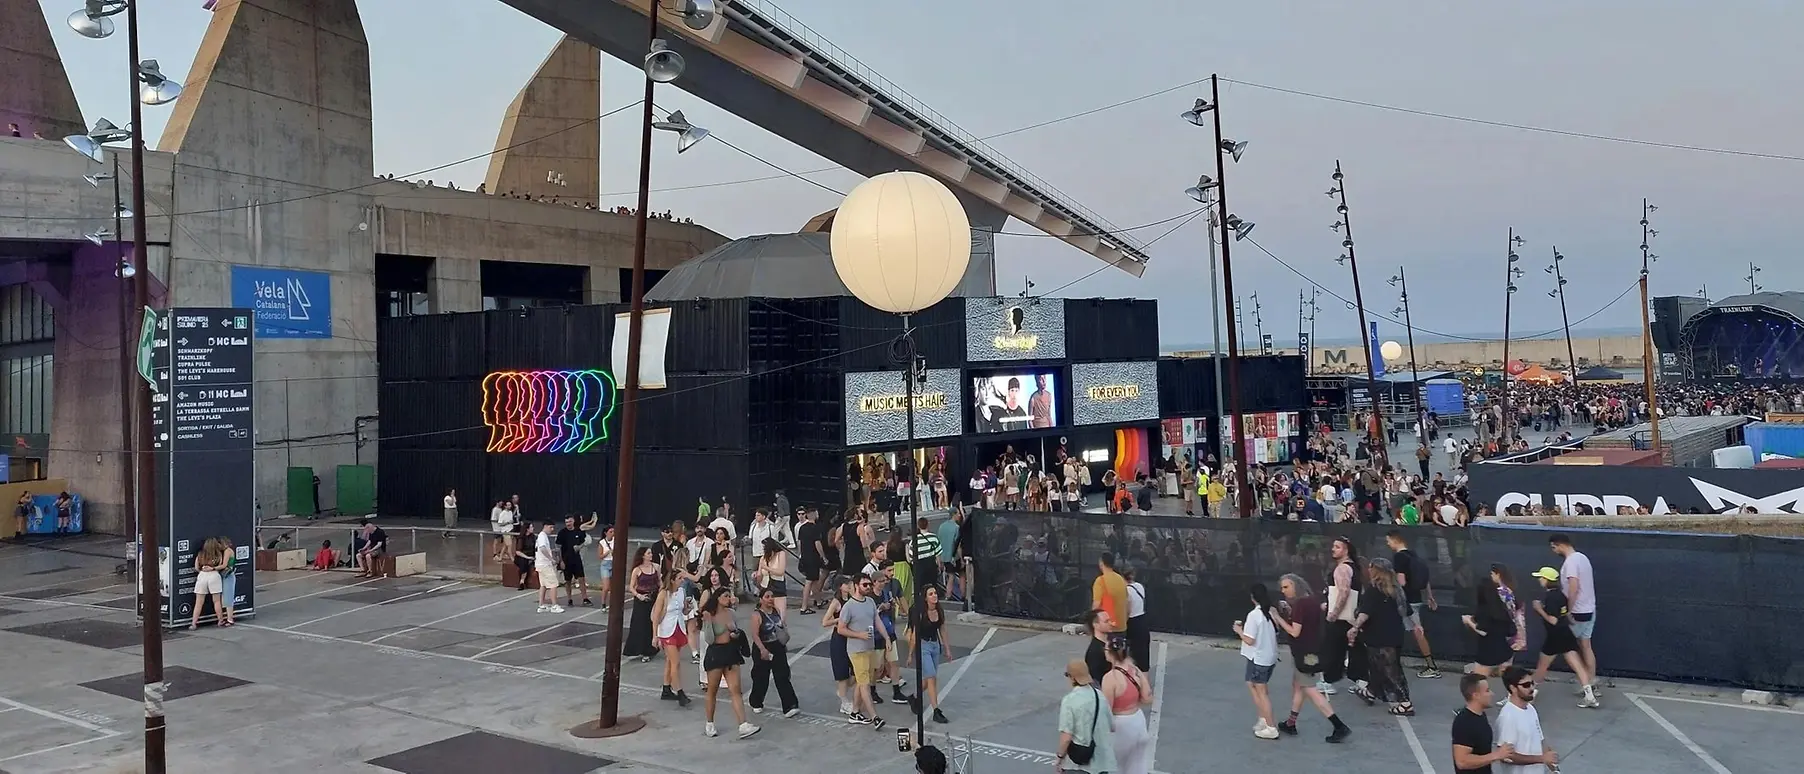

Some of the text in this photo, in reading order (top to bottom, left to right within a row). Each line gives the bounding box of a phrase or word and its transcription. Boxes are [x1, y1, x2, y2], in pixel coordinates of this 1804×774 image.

[254, 280, 285, 298] Vela
[256, 300, 286, 309] Catalana
[257, 311, 287, 320] Federació
[1324, 350, 1347, 364] M
[1092, 387, 1106, 399] FOR
[1107, 386, 1126, 398] EVERY
[865, 397, 894, 411] MUSIC
[896, 395, 924, 409] METS
